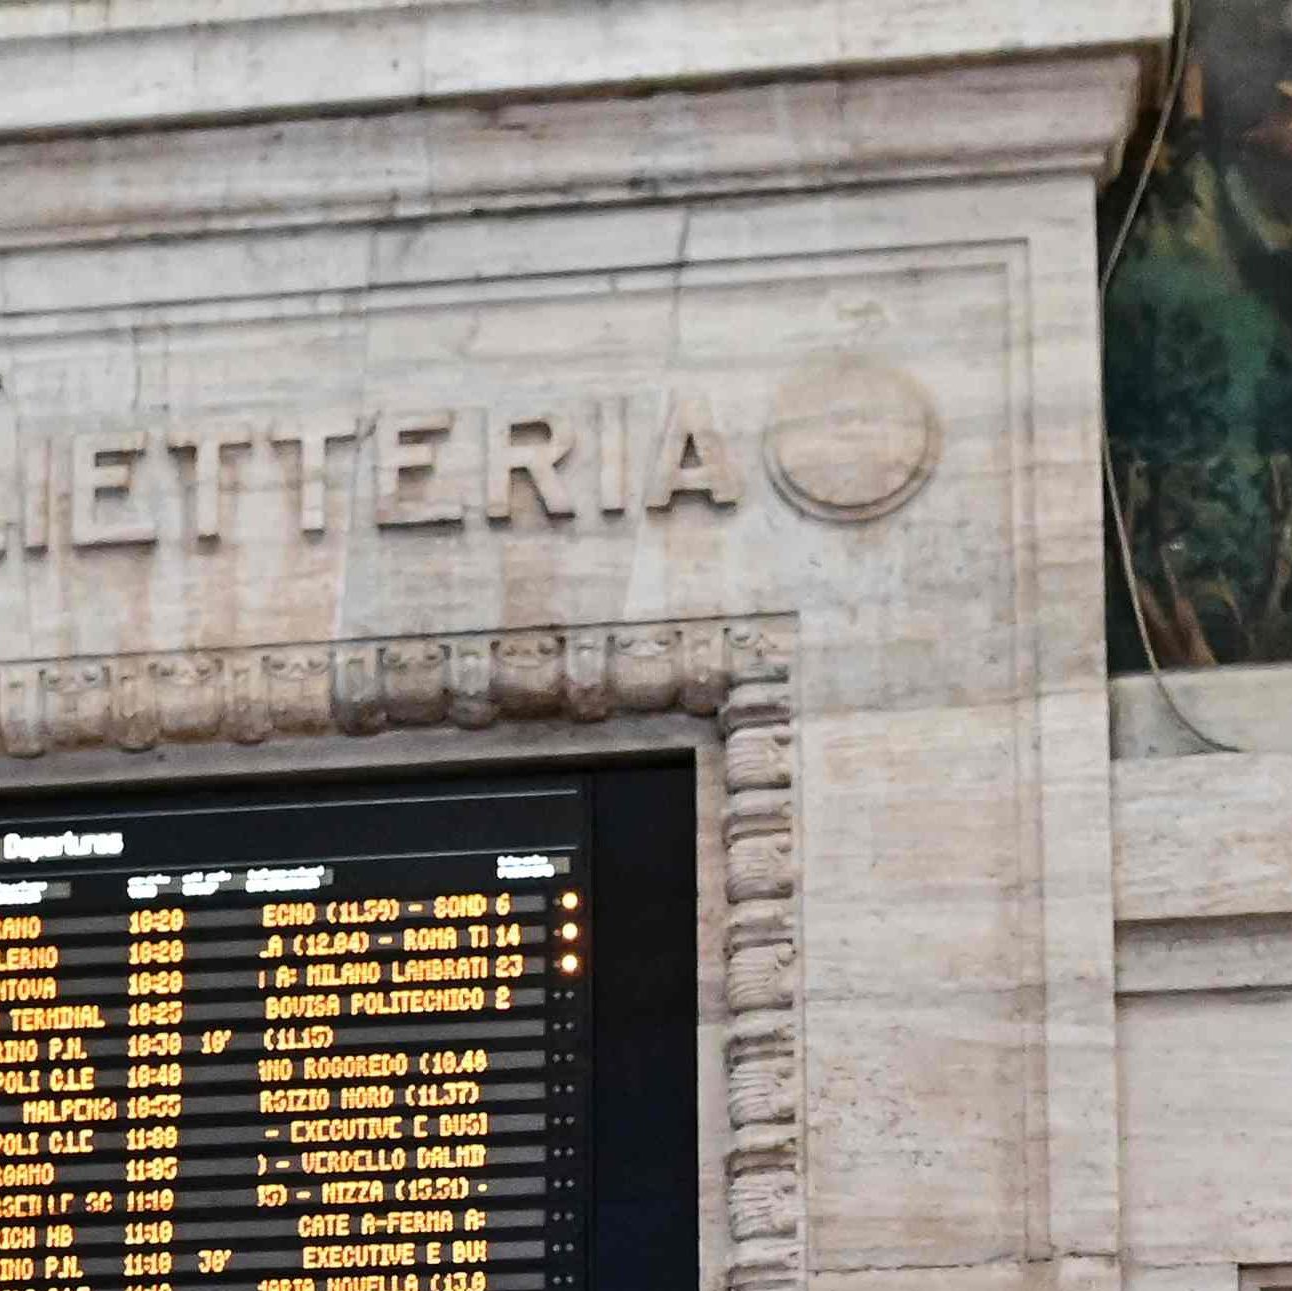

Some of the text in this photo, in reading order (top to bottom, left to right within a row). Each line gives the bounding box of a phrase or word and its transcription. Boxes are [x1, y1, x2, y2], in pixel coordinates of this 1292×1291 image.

[496, 893, 510, 915] 6
[129, 909, 184, 933] 10:20
[404, 927, 457, 950] ROMA
[496, 924, 520, 947] 14
[129, 940, 183, 964] 10:20
[307, 962, 381, 986] MILANO
[496, 955, 523, 977] 23
[128, 971, 182, 995] 10:20
[266, 987, 484, 1019] BOVISA POLITECNICO
[495, 986, 510, 1009] 2
[10, 1005, 105, 1031] TERMINAL
[128, 1001, 182, 1026] 10:25
[49, 1037, 87, 1060] P.N.
[128, 1033, 182, 1057] 10:30
[128, 1064, 182, 1088] 10:40
[304, 1053, 408, 1079] ROGOREDO
[341, 1086, 394, 1109] NORD
[23, 1098, 117, 1123] MALPENS
[127, 1126, 177, 1150] 11:00
[126, 1157, 177, 1181] 11:05
[322, 1181, 383, 1203] NIZZA
[125, 1221, 172, 1244] 11:10
[45, 1256, 83, 1278] P.N.
[124, 1252, 172, 1275] 11:10
[303, 1243, 415, 1268] EXECUTIVE
[427, 1242, 441, 1264] E
